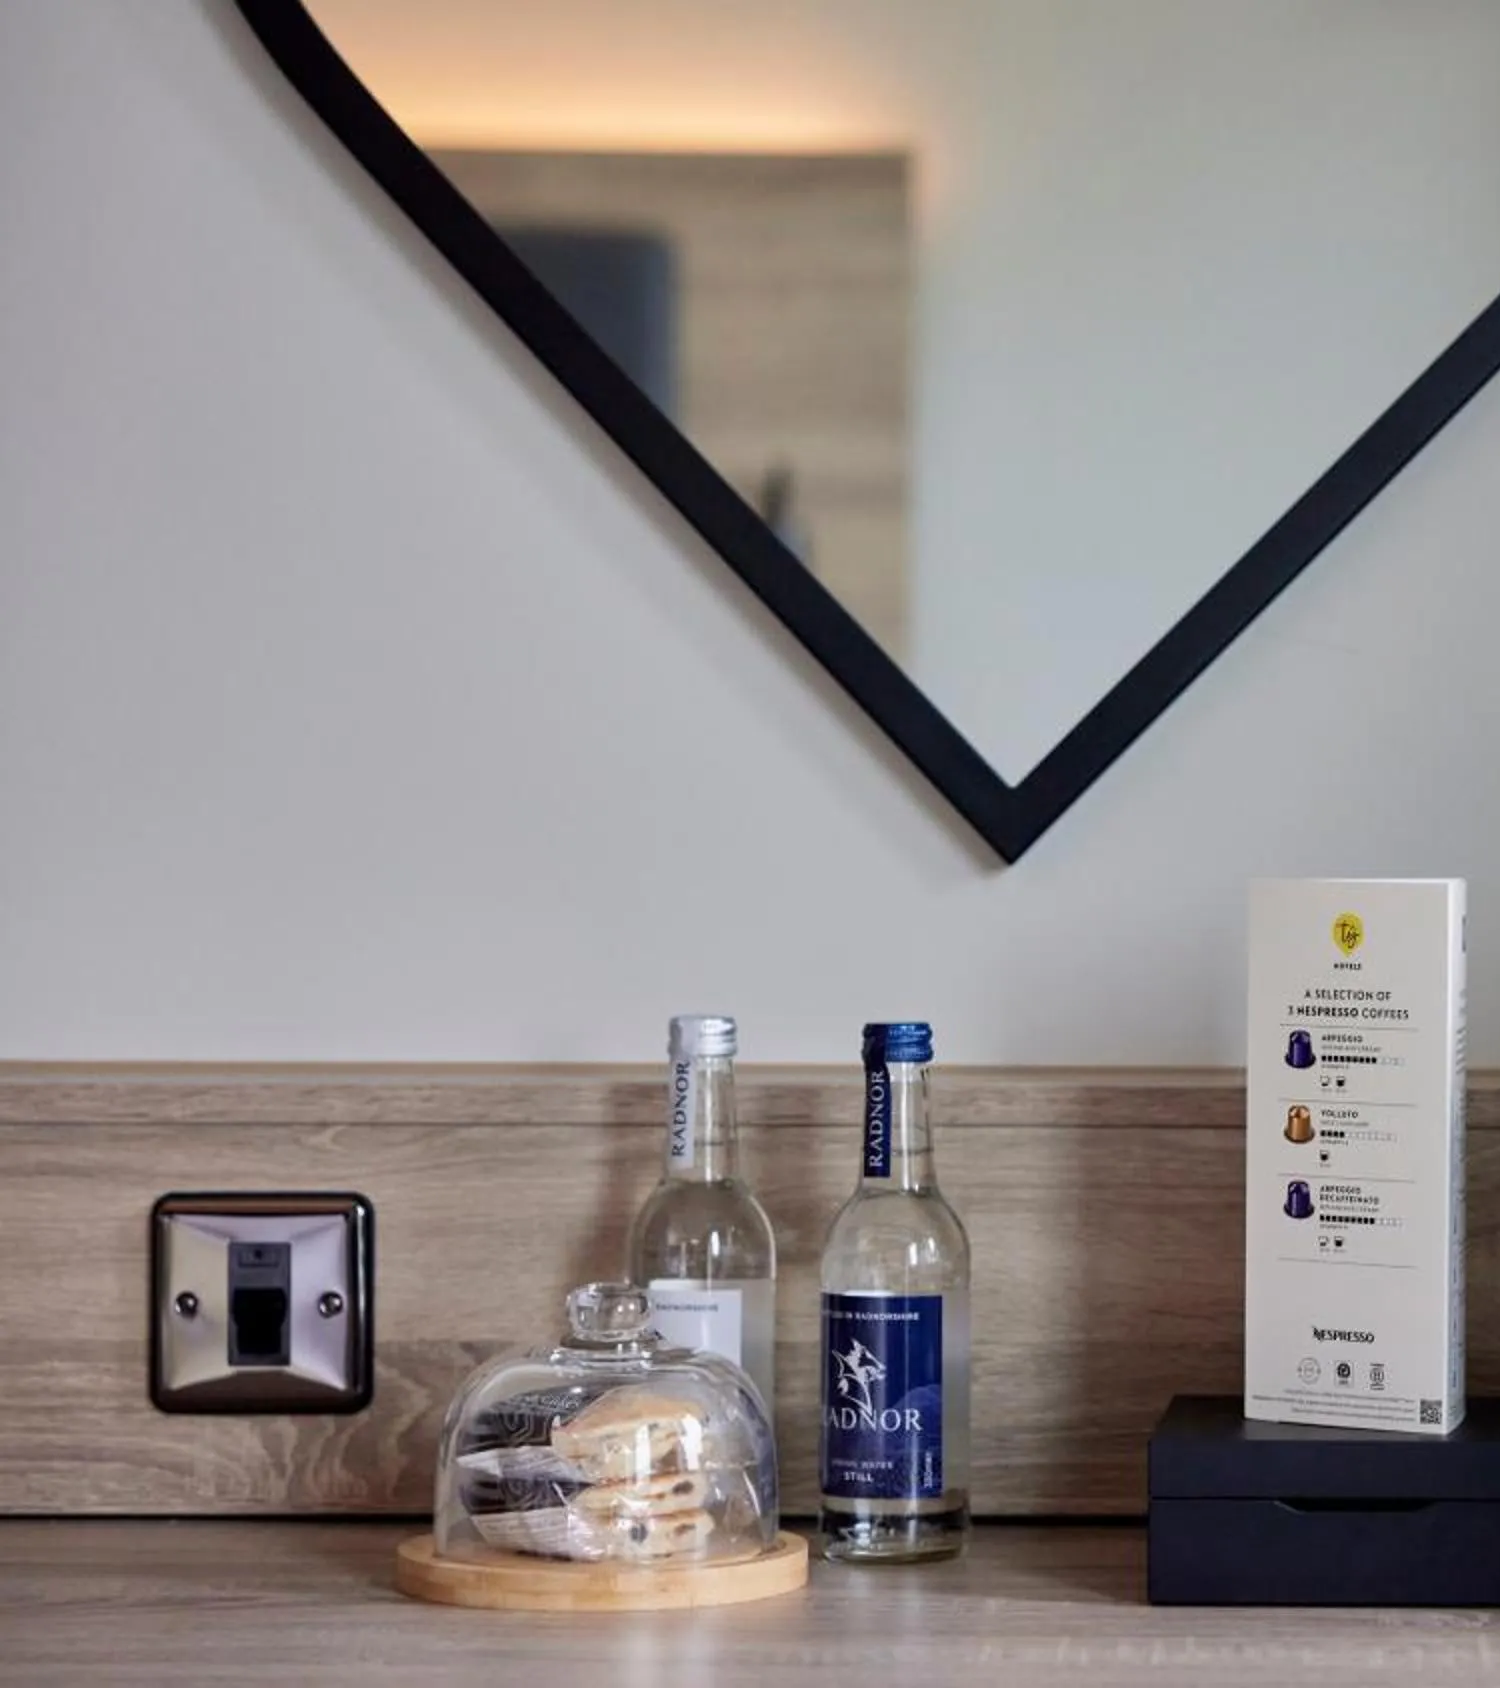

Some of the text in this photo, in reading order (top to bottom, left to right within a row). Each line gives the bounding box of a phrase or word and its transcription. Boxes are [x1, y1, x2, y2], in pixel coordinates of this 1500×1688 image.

[1304, 989, 1392, 1001] A SELECTION OF
[1297, 1006, 1359, 1017] NESPRESSO
[1362, 1008, 1409, 1019] COFFEES
[671, 1060, 690, 1157] RADNOR
[868, 1070, 885, 1168] RADNOR
[1313, 1325, 1375, 1343] NESPRESSO
[829, 1407, 923, 1432] ADNOR
